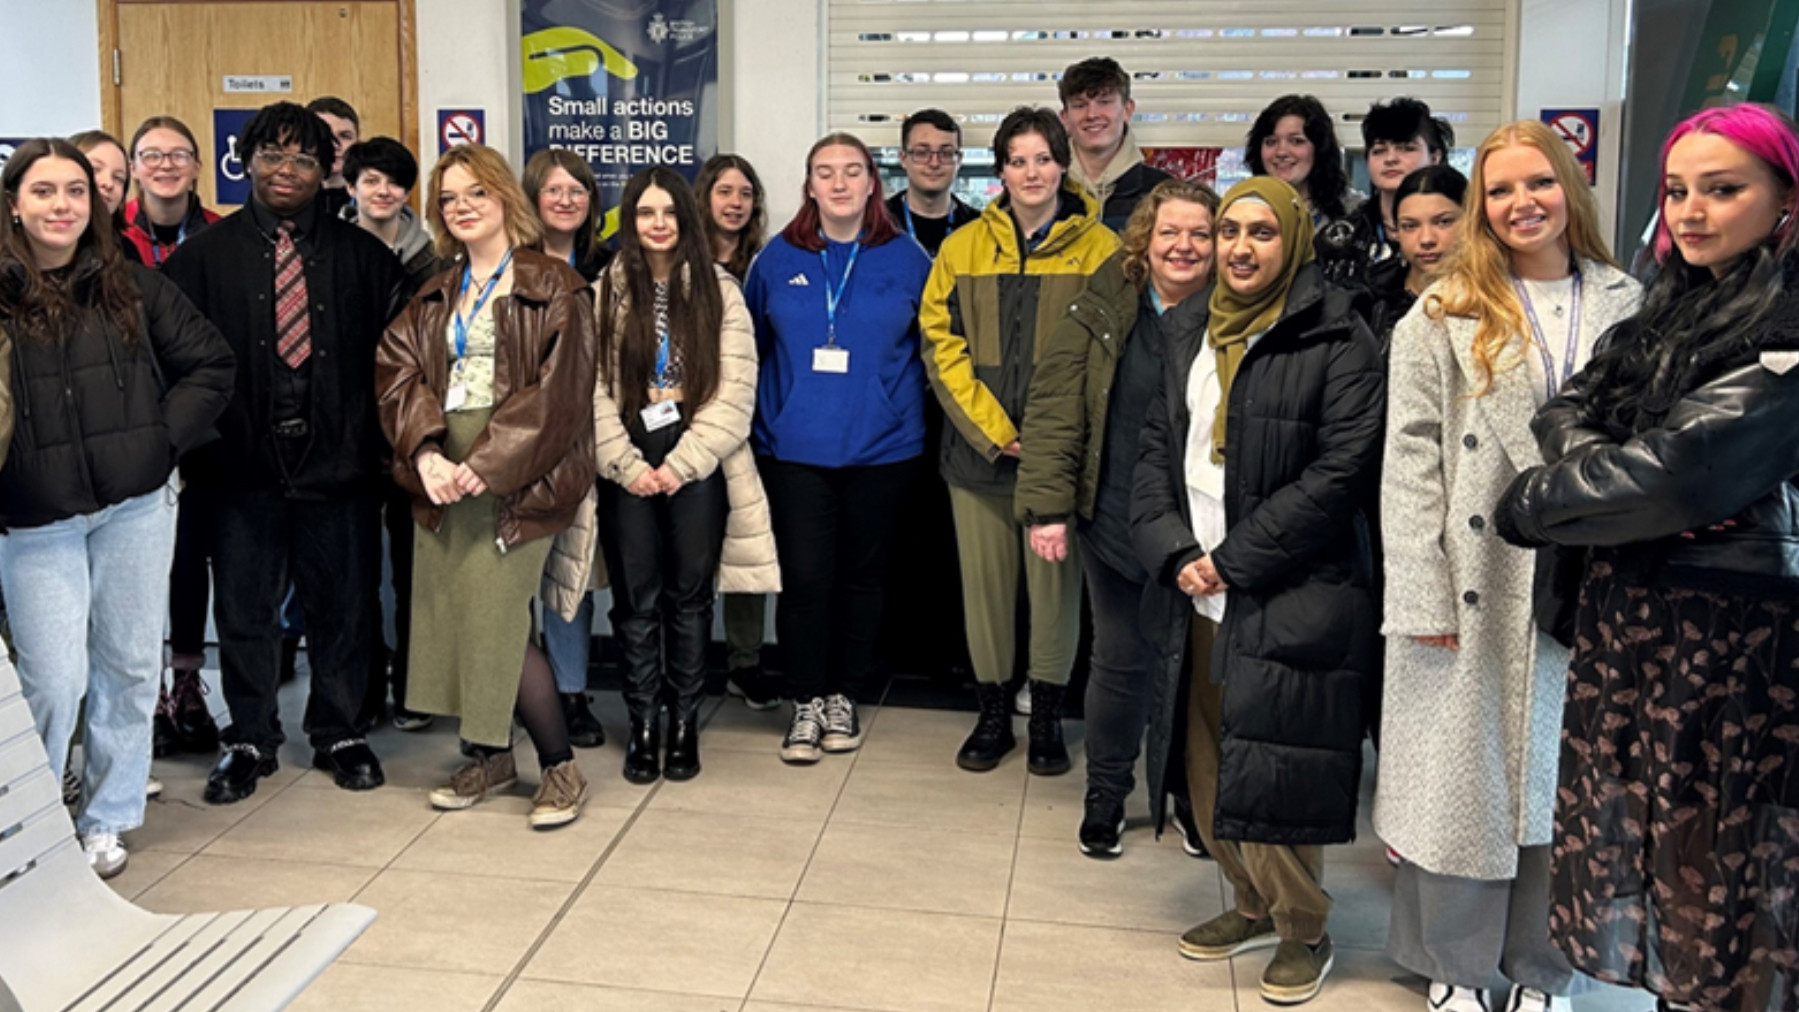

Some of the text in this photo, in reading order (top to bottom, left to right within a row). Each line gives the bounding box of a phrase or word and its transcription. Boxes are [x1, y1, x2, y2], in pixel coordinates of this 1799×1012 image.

[228, 78, 265, 90] Toilets
[548, 95, 694, 115] Small actions
[549, 120, 668, 140] make a BIG
